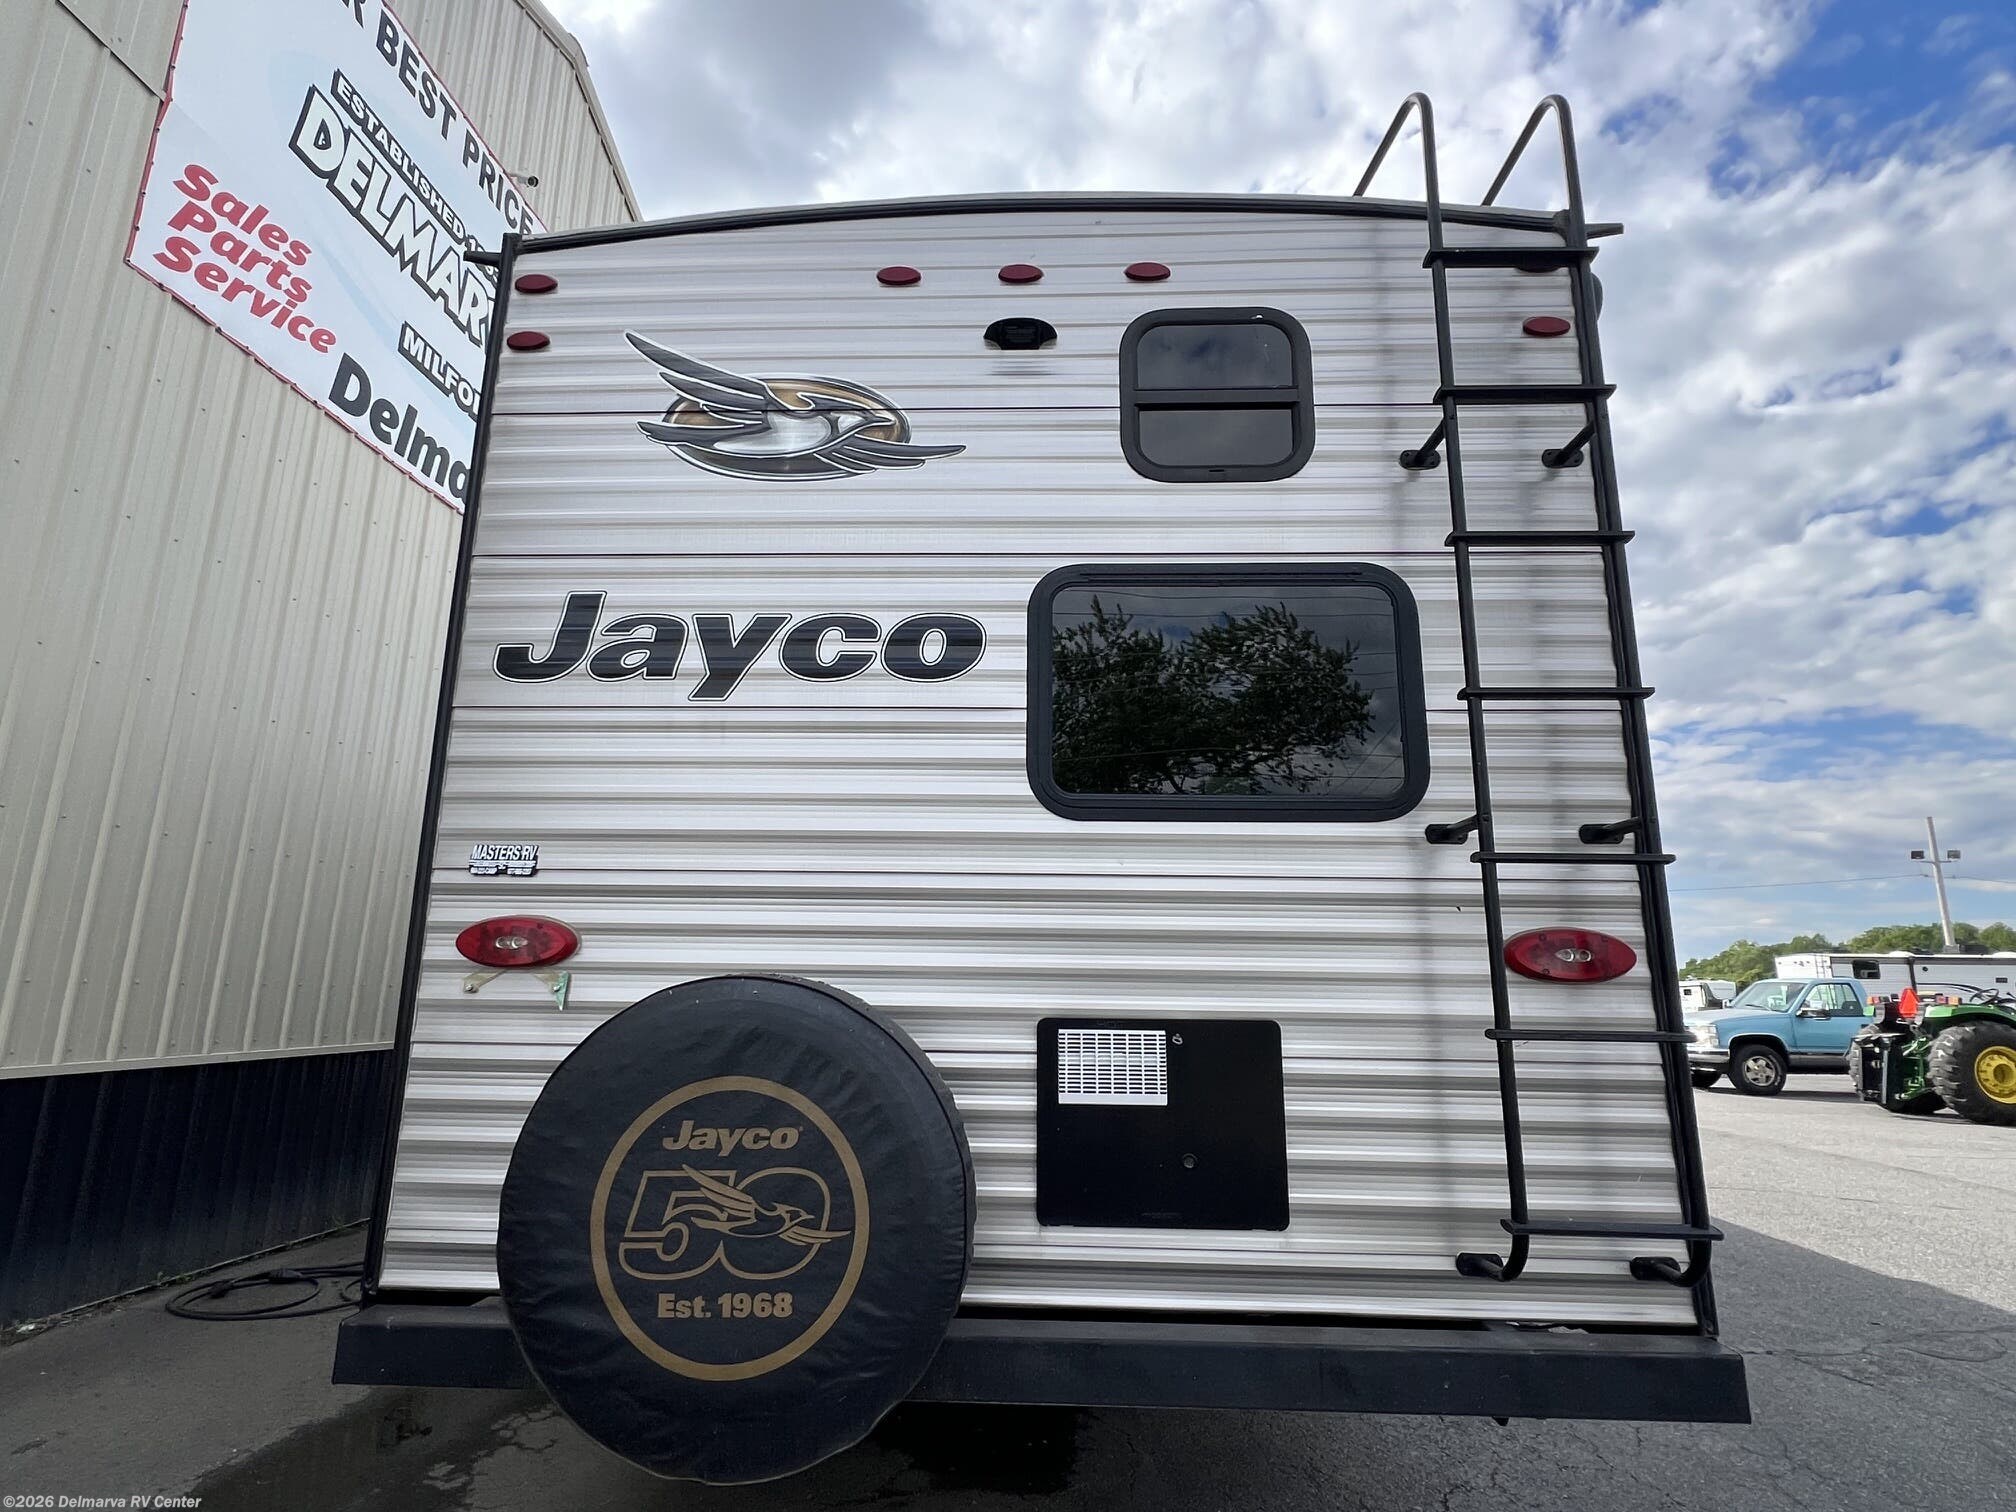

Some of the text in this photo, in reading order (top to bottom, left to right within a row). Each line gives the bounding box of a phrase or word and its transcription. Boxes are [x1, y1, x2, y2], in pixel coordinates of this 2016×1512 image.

[376, 9, 457, 140] BEST
[334, 71, 466, 242] ESTABLISHED
[167, 200, 313, 303] Parts
[173, 164, 312, 266] Sales
[153, 236, 337, 353] Service
[398, 321, 481, 423] MILFO
[493, 590, 987, 701] Jayco
[471, 845, 538, 860] MASTERS RV
[662, 1120, 801, 1157] Jayco
[618, 1166, 831, 1281] 50
[657, 1292, 794, 1319] Est. 1968
